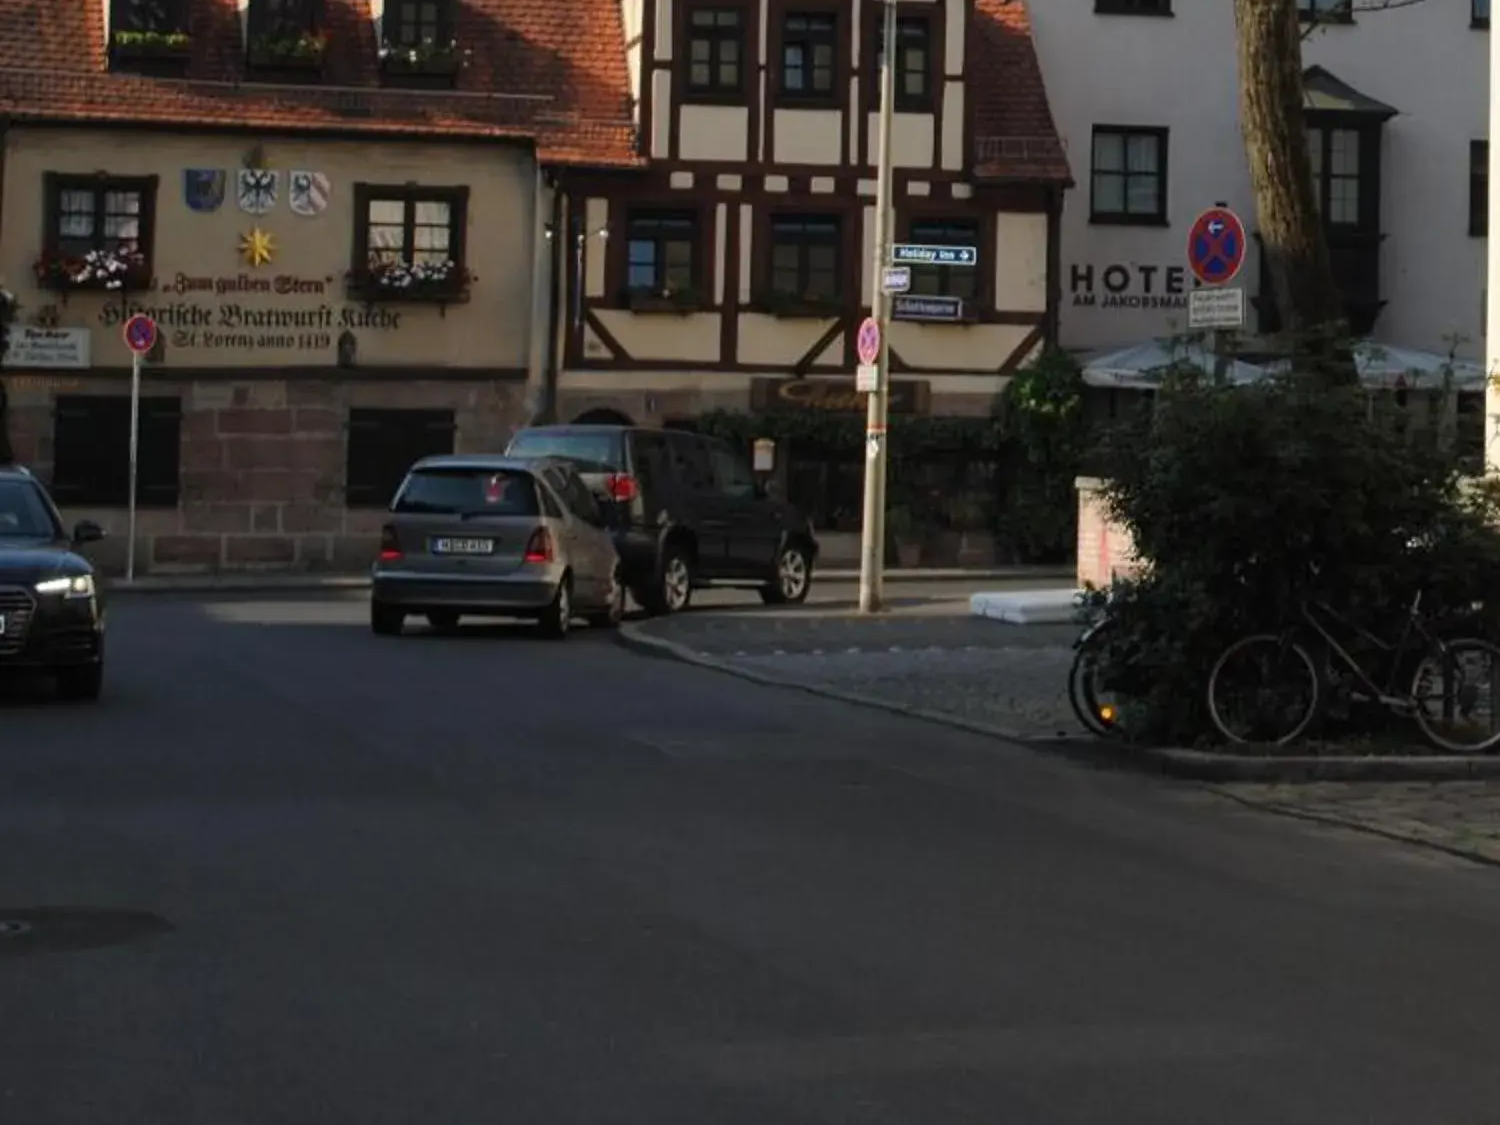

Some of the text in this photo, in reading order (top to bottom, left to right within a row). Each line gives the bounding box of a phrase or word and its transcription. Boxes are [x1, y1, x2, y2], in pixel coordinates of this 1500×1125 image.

[1070, 263, 1202, 294] HOTE
[1072, 295, 1096, 307] AM
[218, 301, 333, 329] Bratwurst
[256, 333, 295, 349] anno
